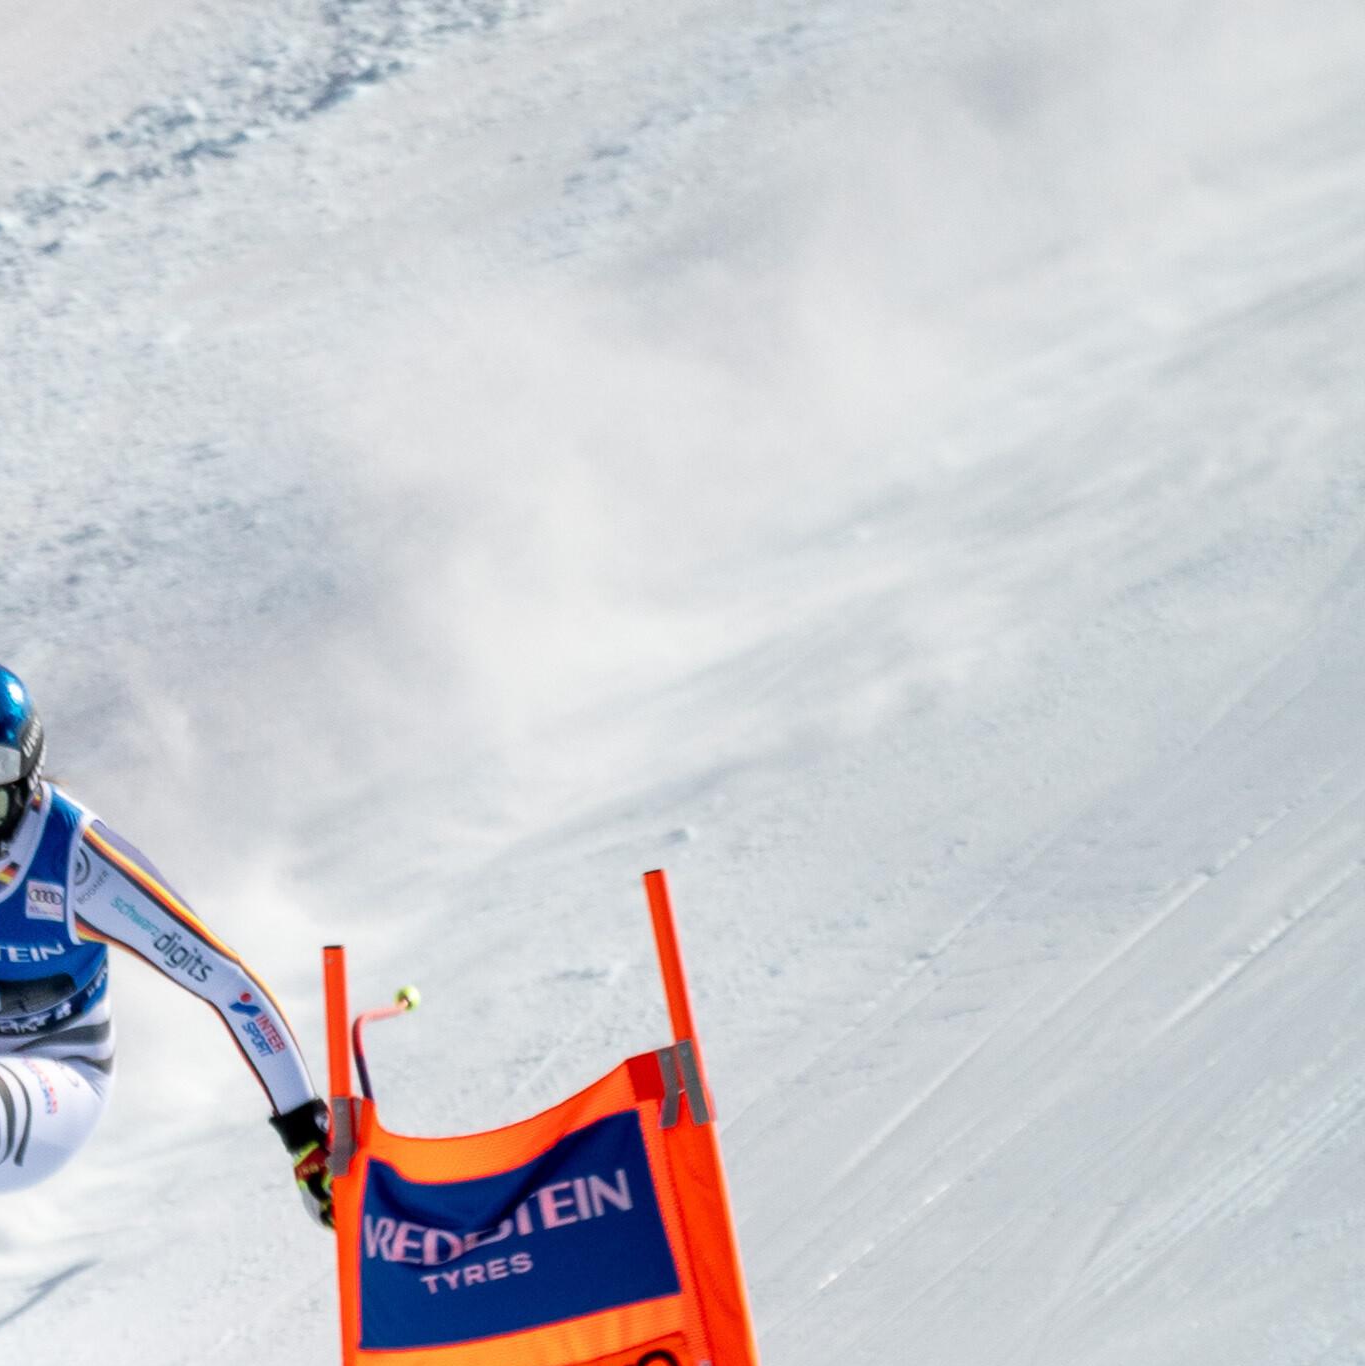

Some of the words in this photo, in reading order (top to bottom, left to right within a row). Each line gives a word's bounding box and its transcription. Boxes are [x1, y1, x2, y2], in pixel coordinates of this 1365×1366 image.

[153, 931, 214, 983] digits
[241, 1021, 275, 1057] SPORT
[255, 1014, 286, 1053] INTER
[420, 1252, 535, 1295] TYRES
